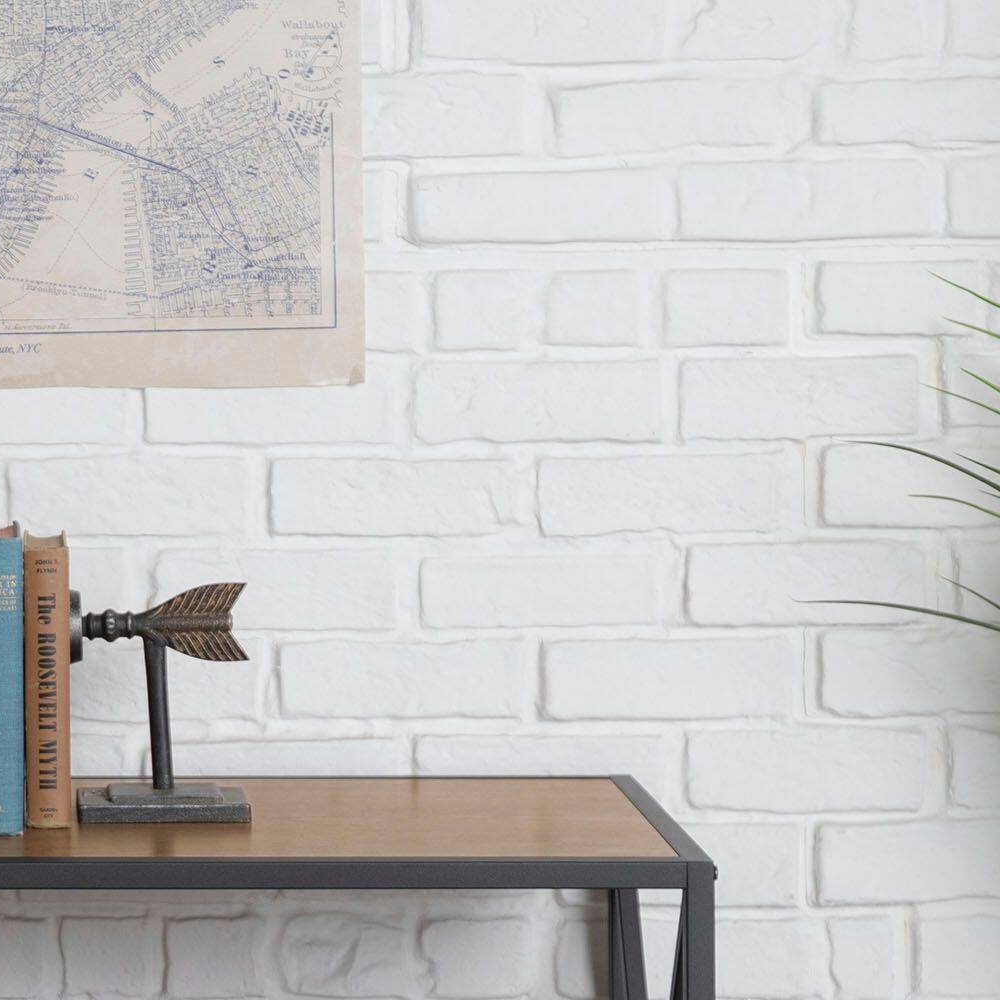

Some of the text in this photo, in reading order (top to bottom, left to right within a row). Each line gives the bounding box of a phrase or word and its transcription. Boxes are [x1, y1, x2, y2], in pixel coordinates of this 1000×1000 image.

[16, 343, 43, 353] NYC
[38, 593, 57, 789] The ROOSEVELT MYTH
